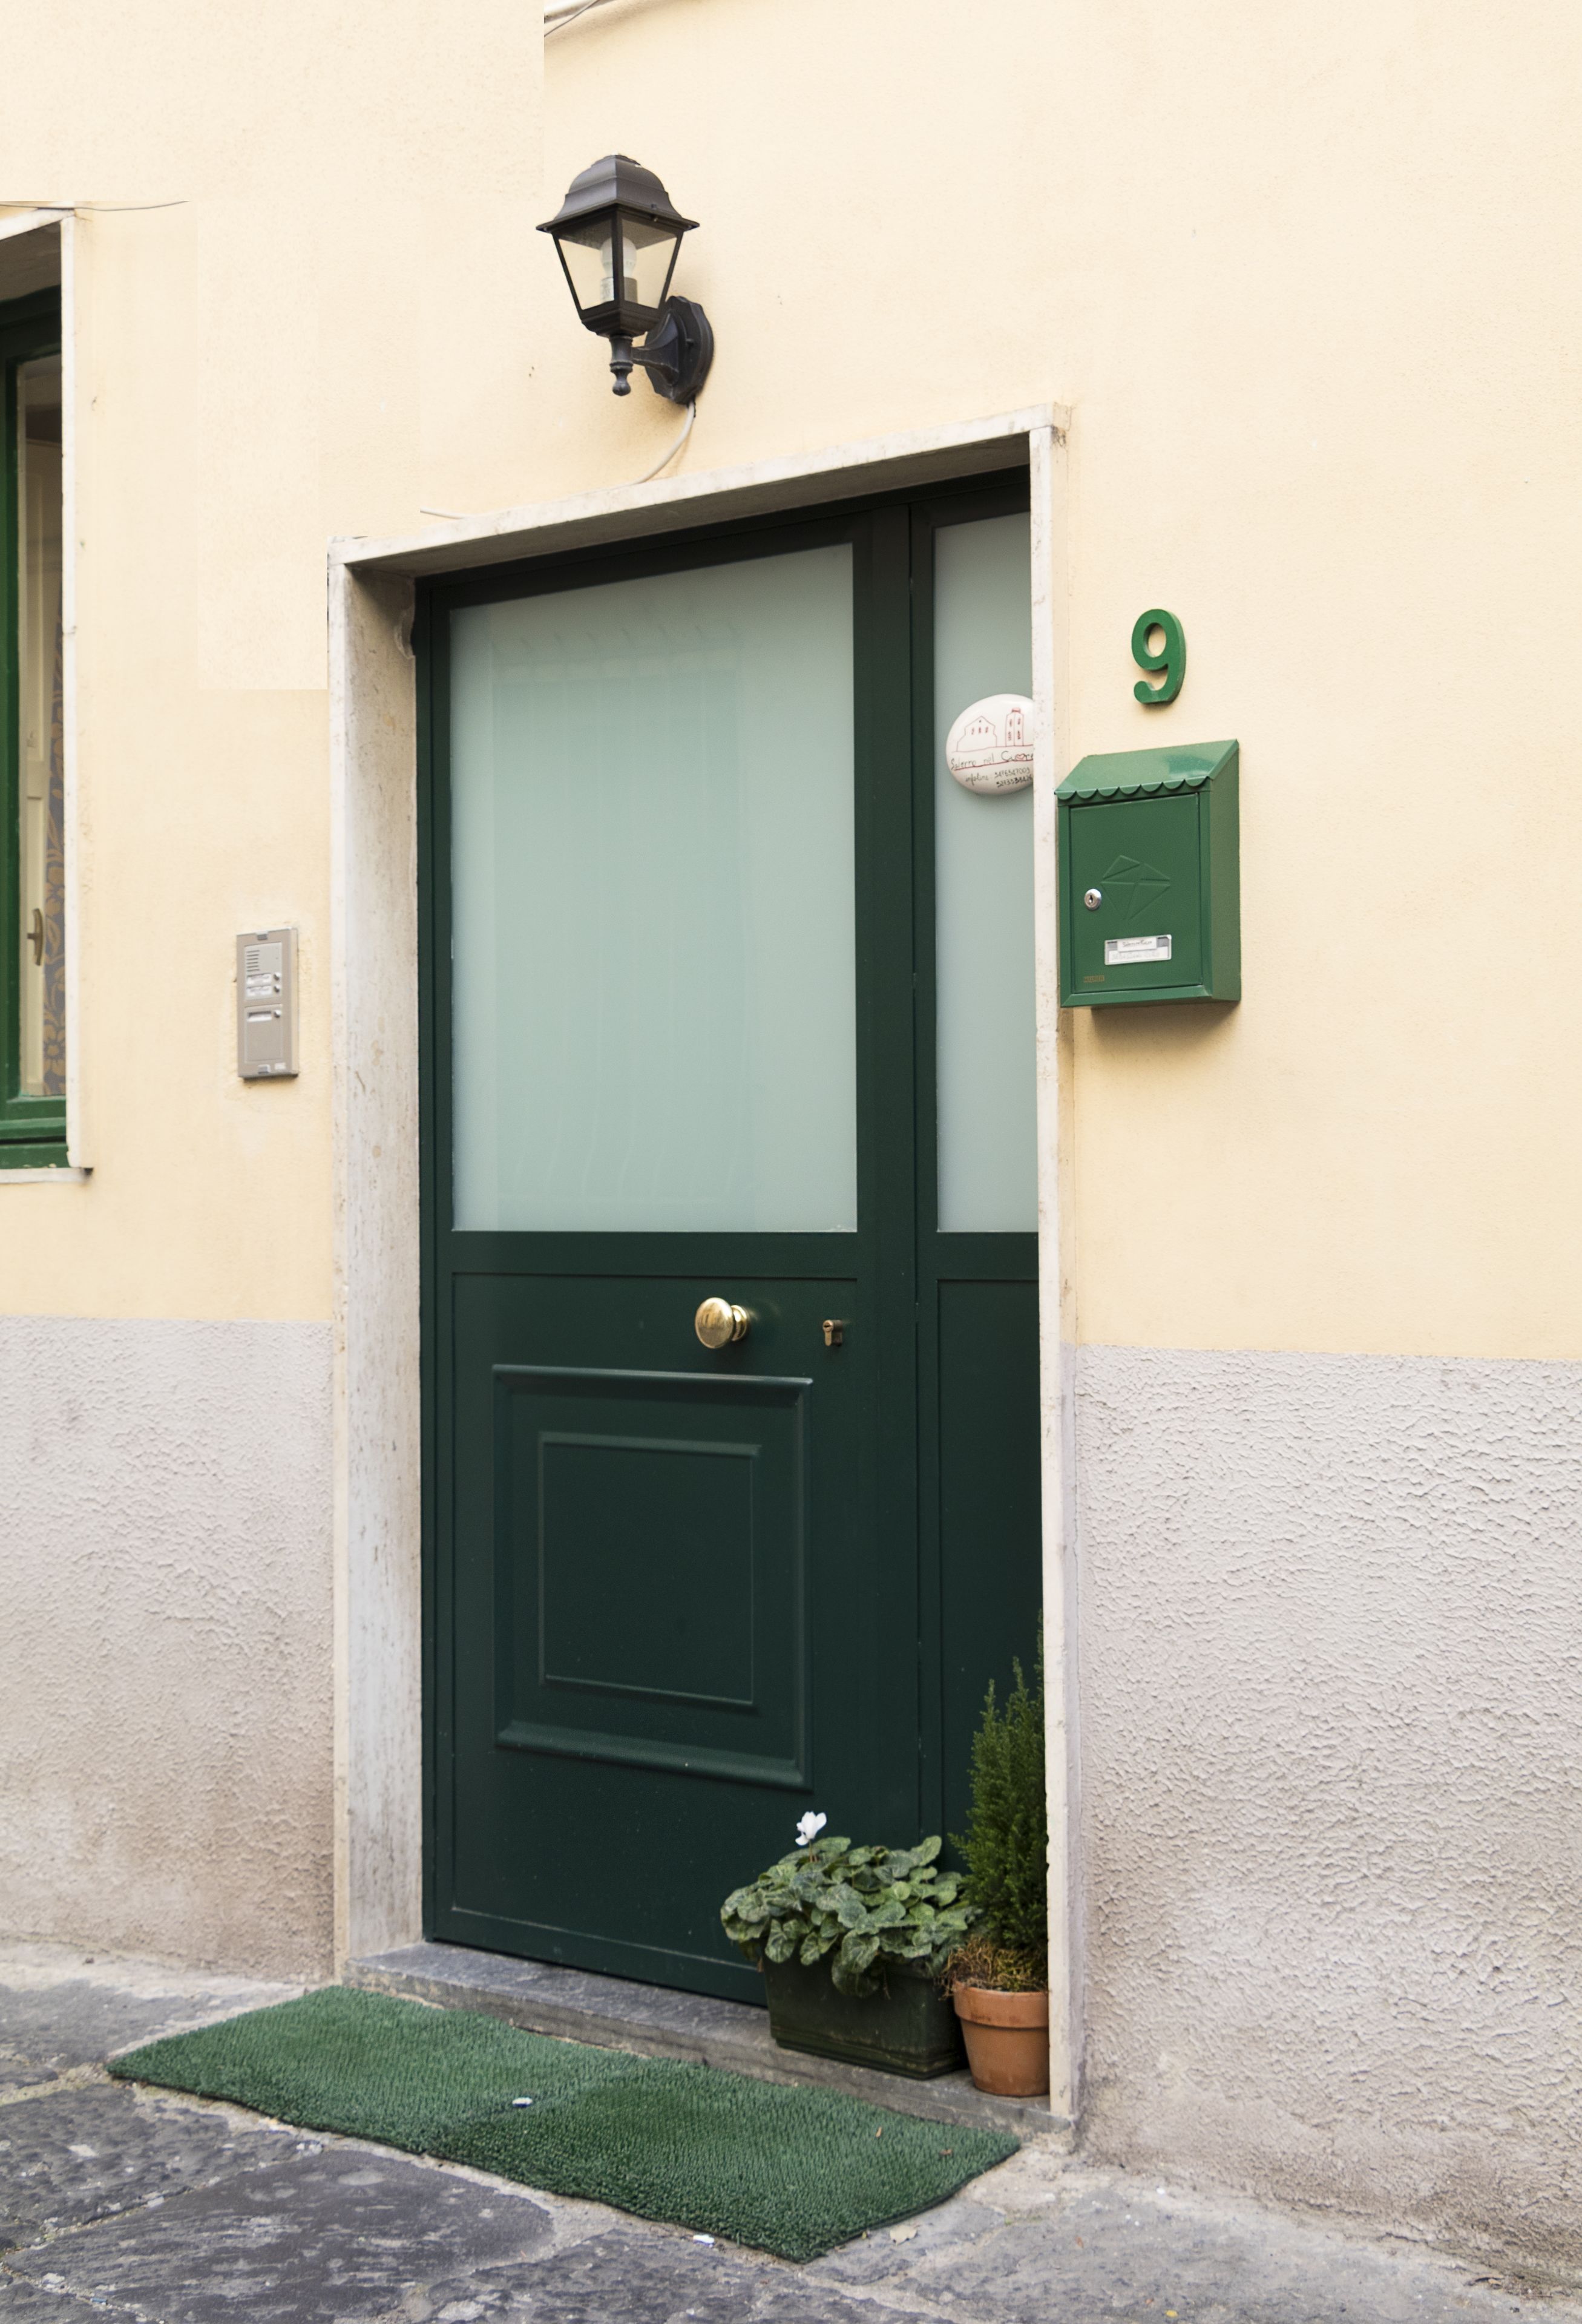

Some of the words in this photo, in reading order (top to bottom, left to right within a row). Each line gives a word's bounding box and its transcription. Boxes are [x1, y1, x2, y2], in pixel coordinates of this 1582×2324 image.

[1131, 609, 1186, 704] 9
[951, 757, 976, 770] Salerno
[983, 753, 994, 764] nel
